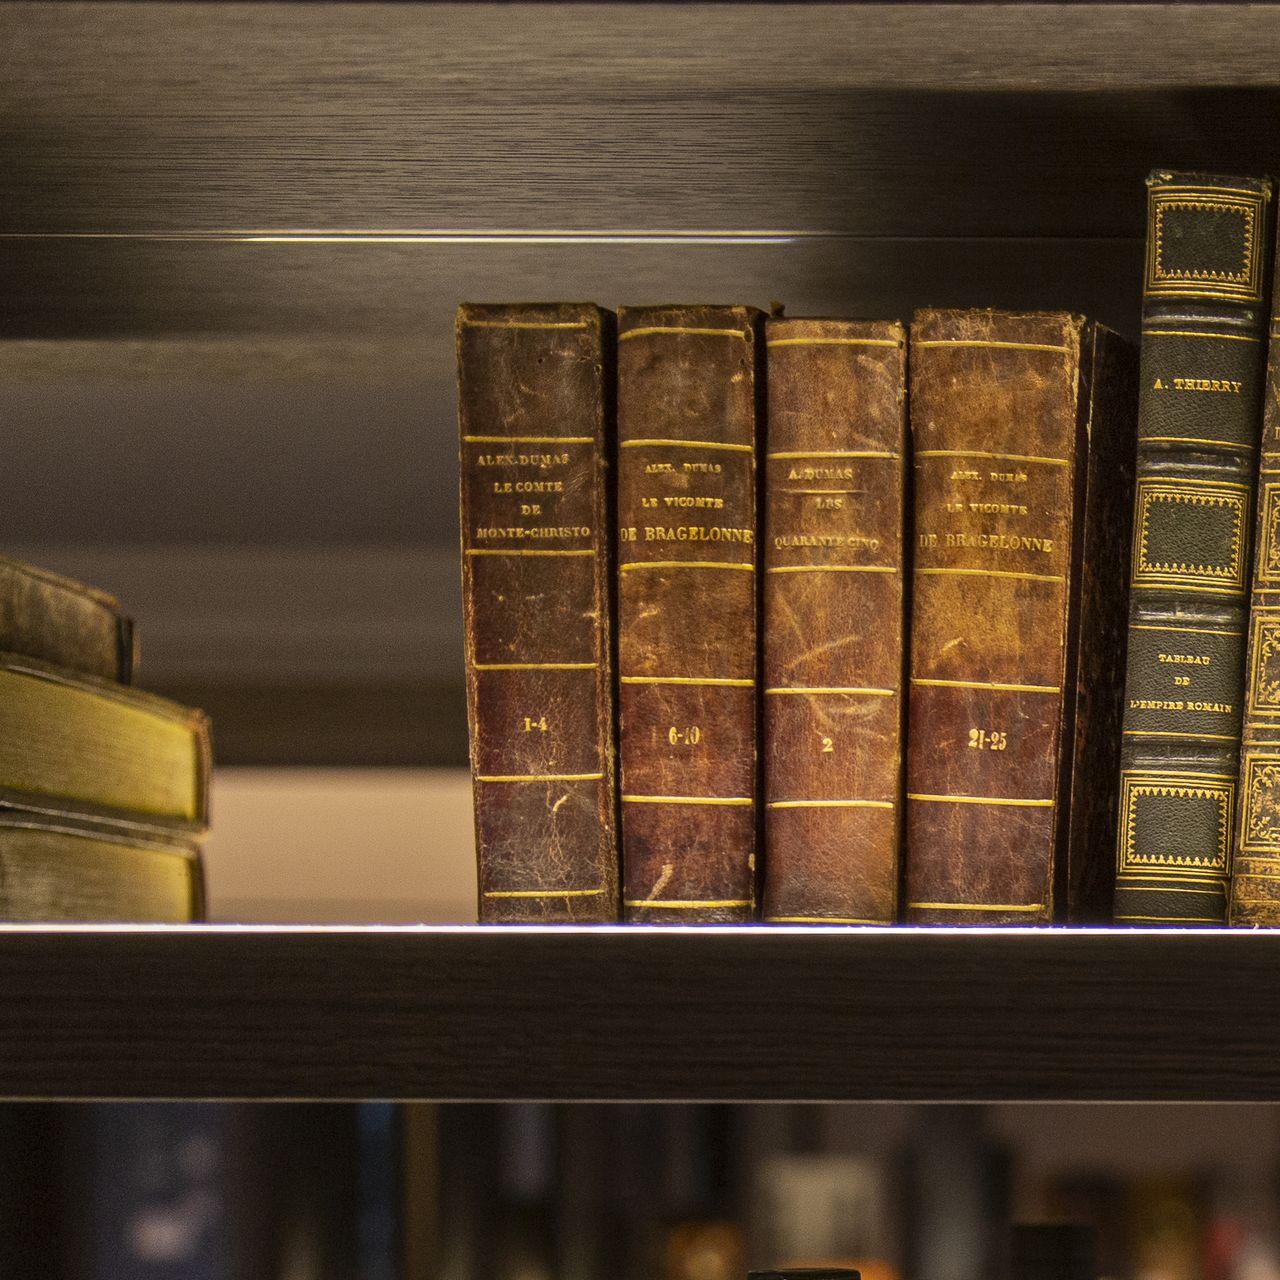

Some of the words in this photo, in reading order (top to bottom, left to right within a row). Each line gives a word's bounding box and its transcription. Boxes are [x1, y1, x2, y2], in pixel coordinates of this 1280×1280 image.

[1154, 378, 1169, 390] A.
[1174, 378, 1242, 393] THIERRY
[494, 482, 512, 493] LE
[515, 480, 563, 492] COMTE
[641, 498, 659, 508] LE
[664, 497, 724, 509] VICOMTE
[521, 504, 542, 516] DE
[620, 527, 638, 542] DE
[644, 527, 754, 544] BRAGELONNE
[919, 533, 937, 549] DE
[945, 533, 1053, 553] BRAGELONNE
[1158, 654, 1211, 666] TABLEAU
[1174, 676, 1190, 686] DE
[1186, 701, 1232, 714] ROMAIN
[821, 738, 834, 753] 2
[967, 728, 1008, 752] 21-25
